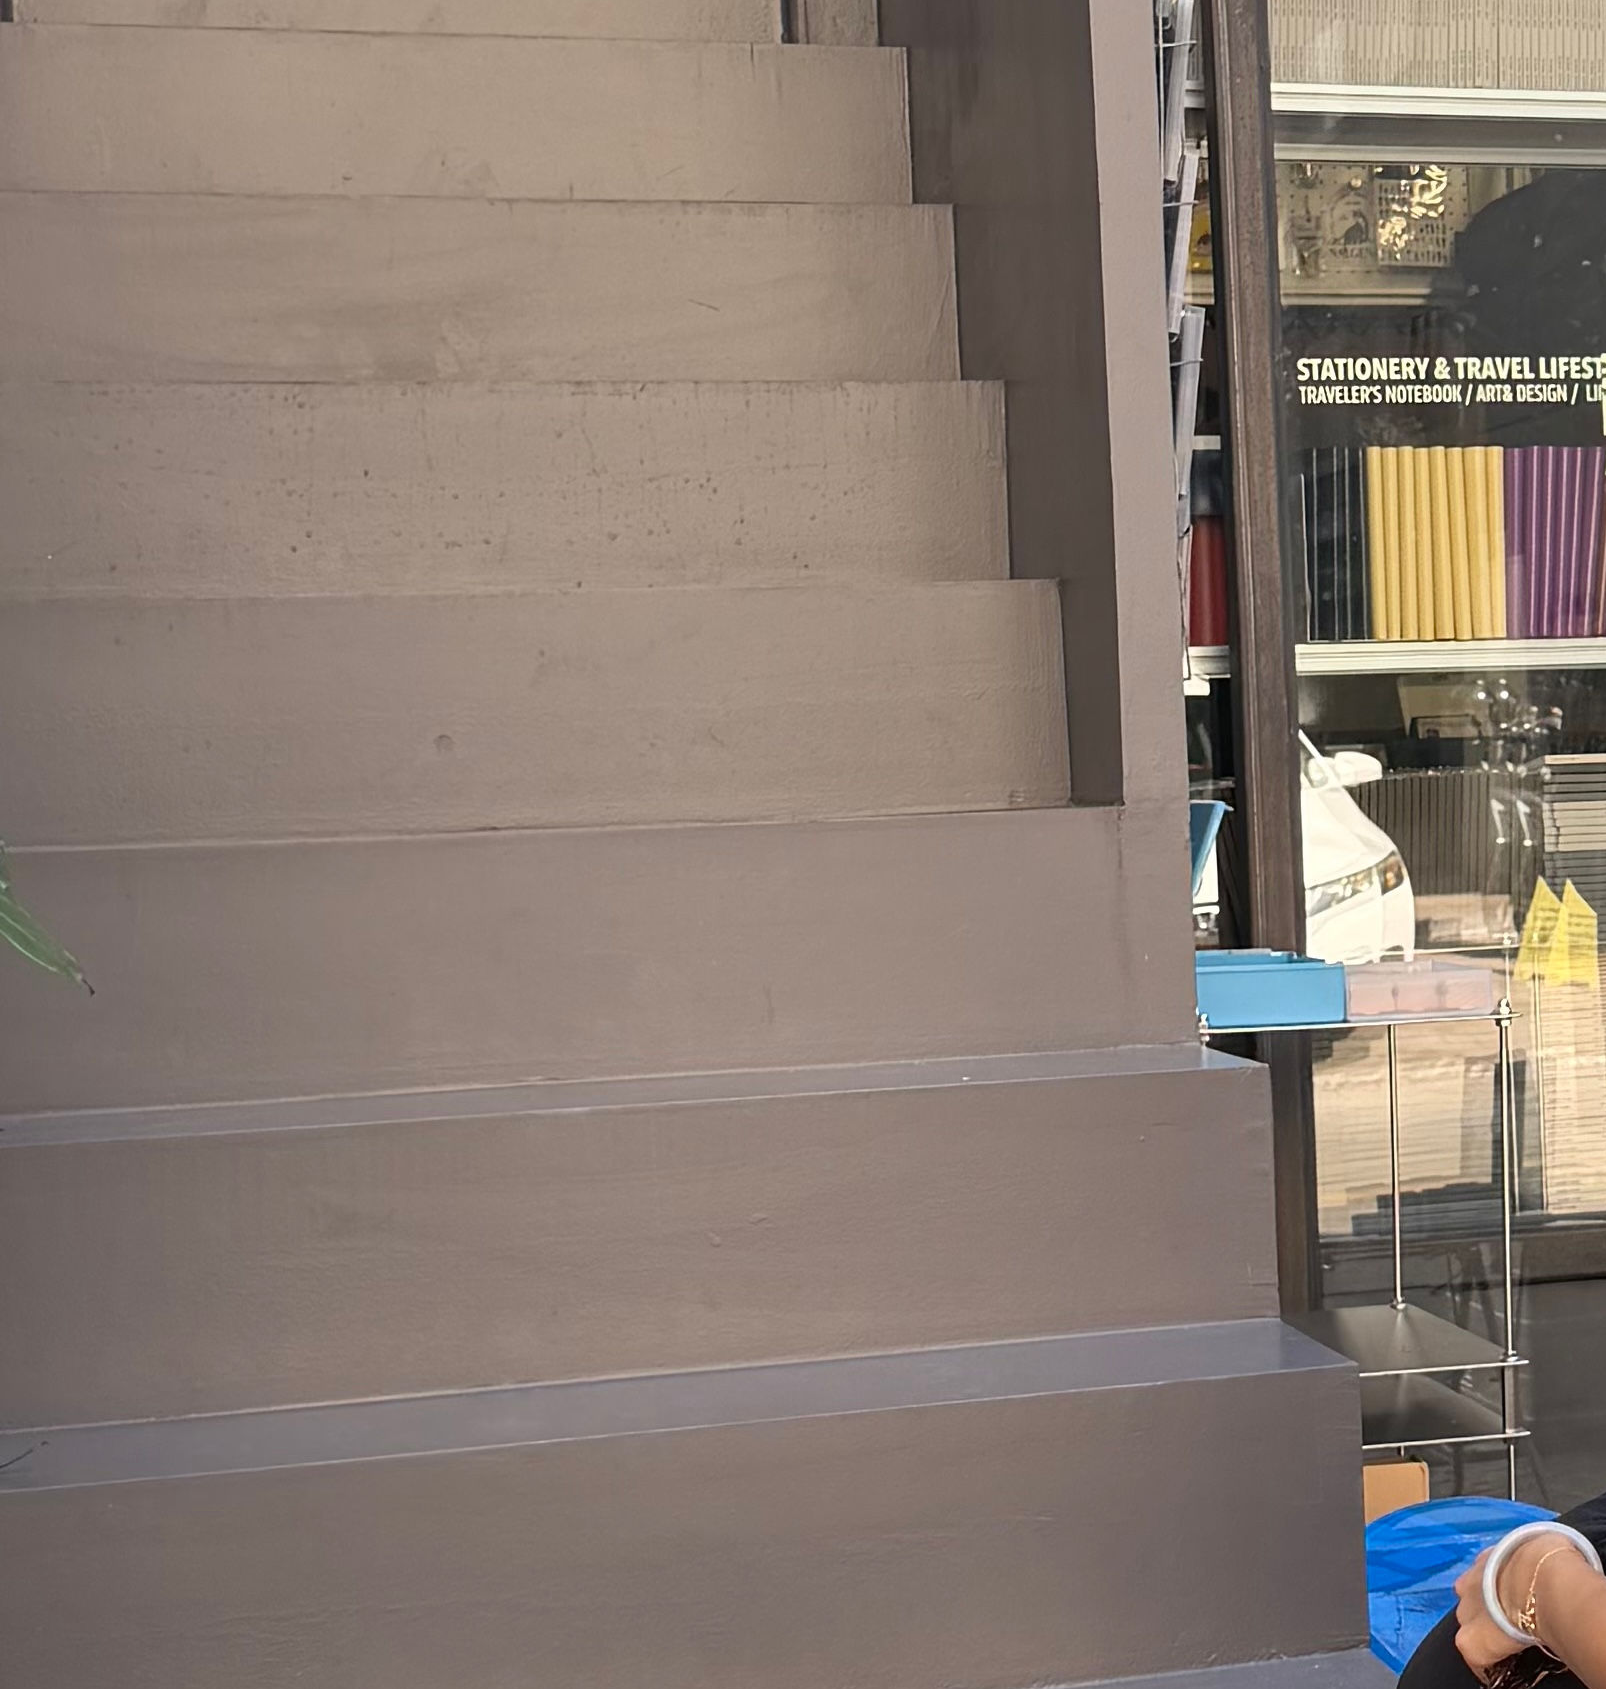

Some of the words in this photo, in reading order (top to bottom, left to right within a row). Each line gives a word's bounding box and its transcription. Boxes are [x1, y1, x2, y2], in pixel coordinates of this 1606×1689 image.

[1296, 357, 1430, 381] STATIONERY
[1433, 357, 1451, 380] &
[1453, 357, 1536, 380] TRAVEL
[1539, 356, 1603, 379] LIFEST
[1298, 385, 1383, 405] TRAVELER'S
[1385, 384, 1463, 404] NOTEBOOK
[1516, 384, 1568, 403] DESIGN
